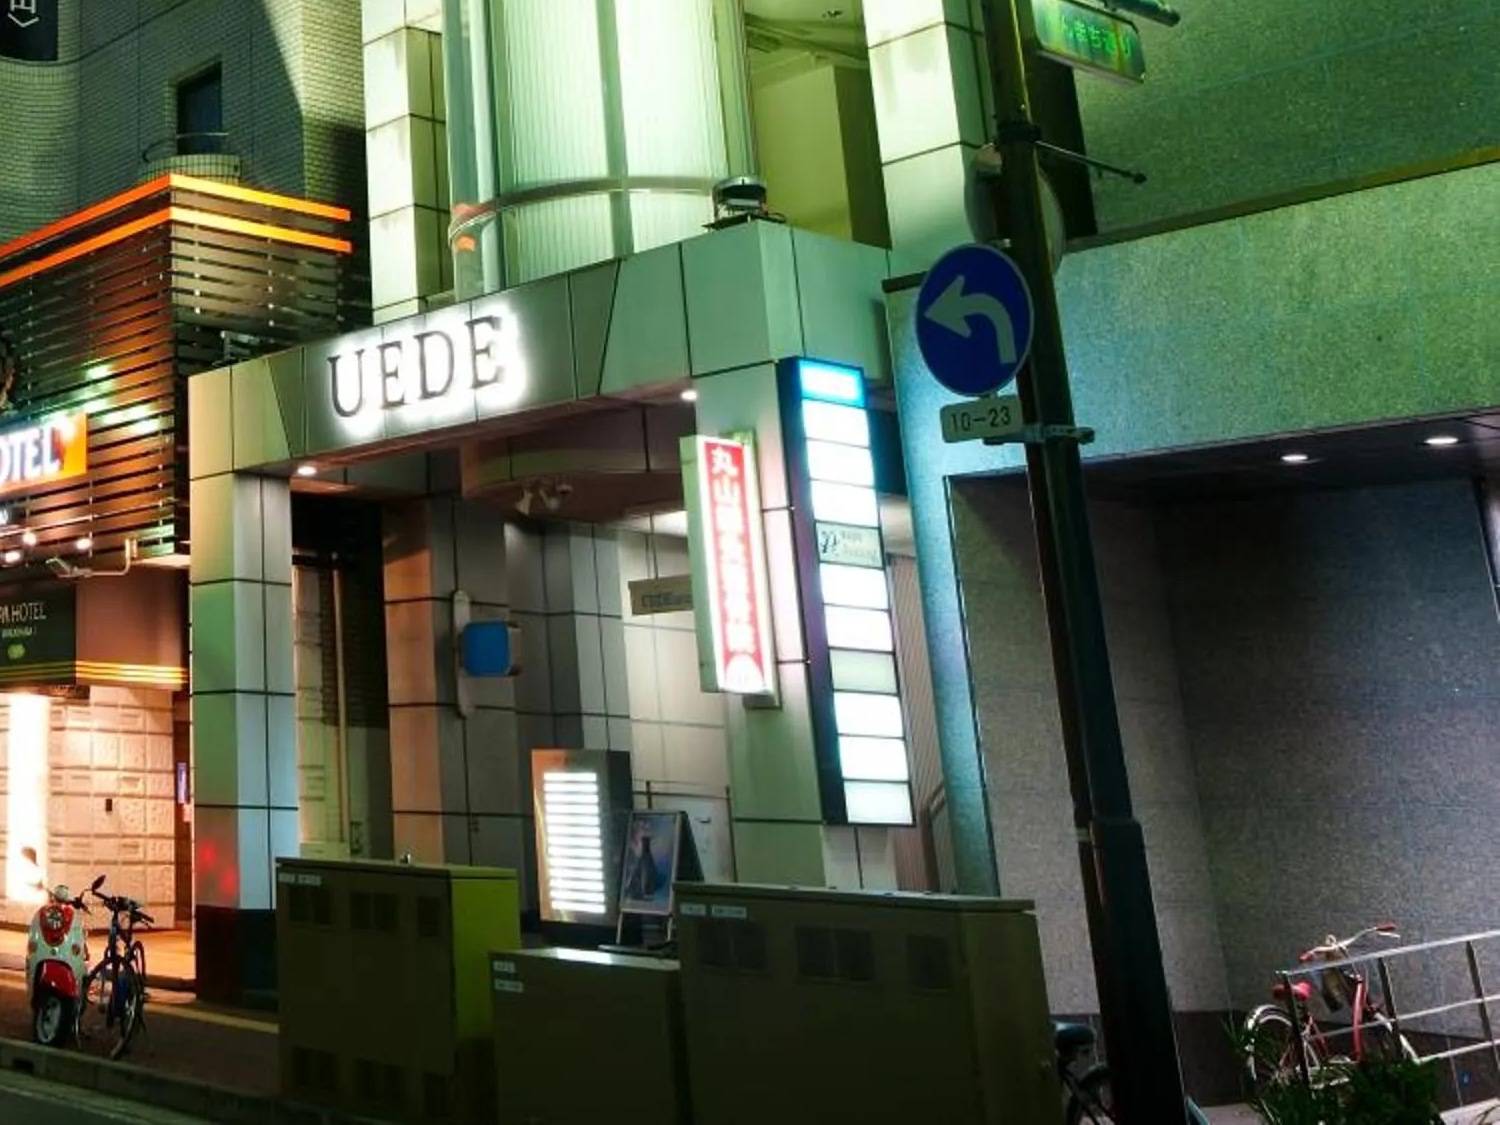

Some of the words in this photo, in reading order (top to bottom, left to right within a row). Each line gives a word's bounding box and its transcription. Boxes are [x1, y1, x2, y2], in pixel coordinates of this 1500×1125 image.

[327, 315, 505, 418] UEDE
[951, 405, 1012, 433] 10-23
[11, 602, 47, 623] HOTEL
